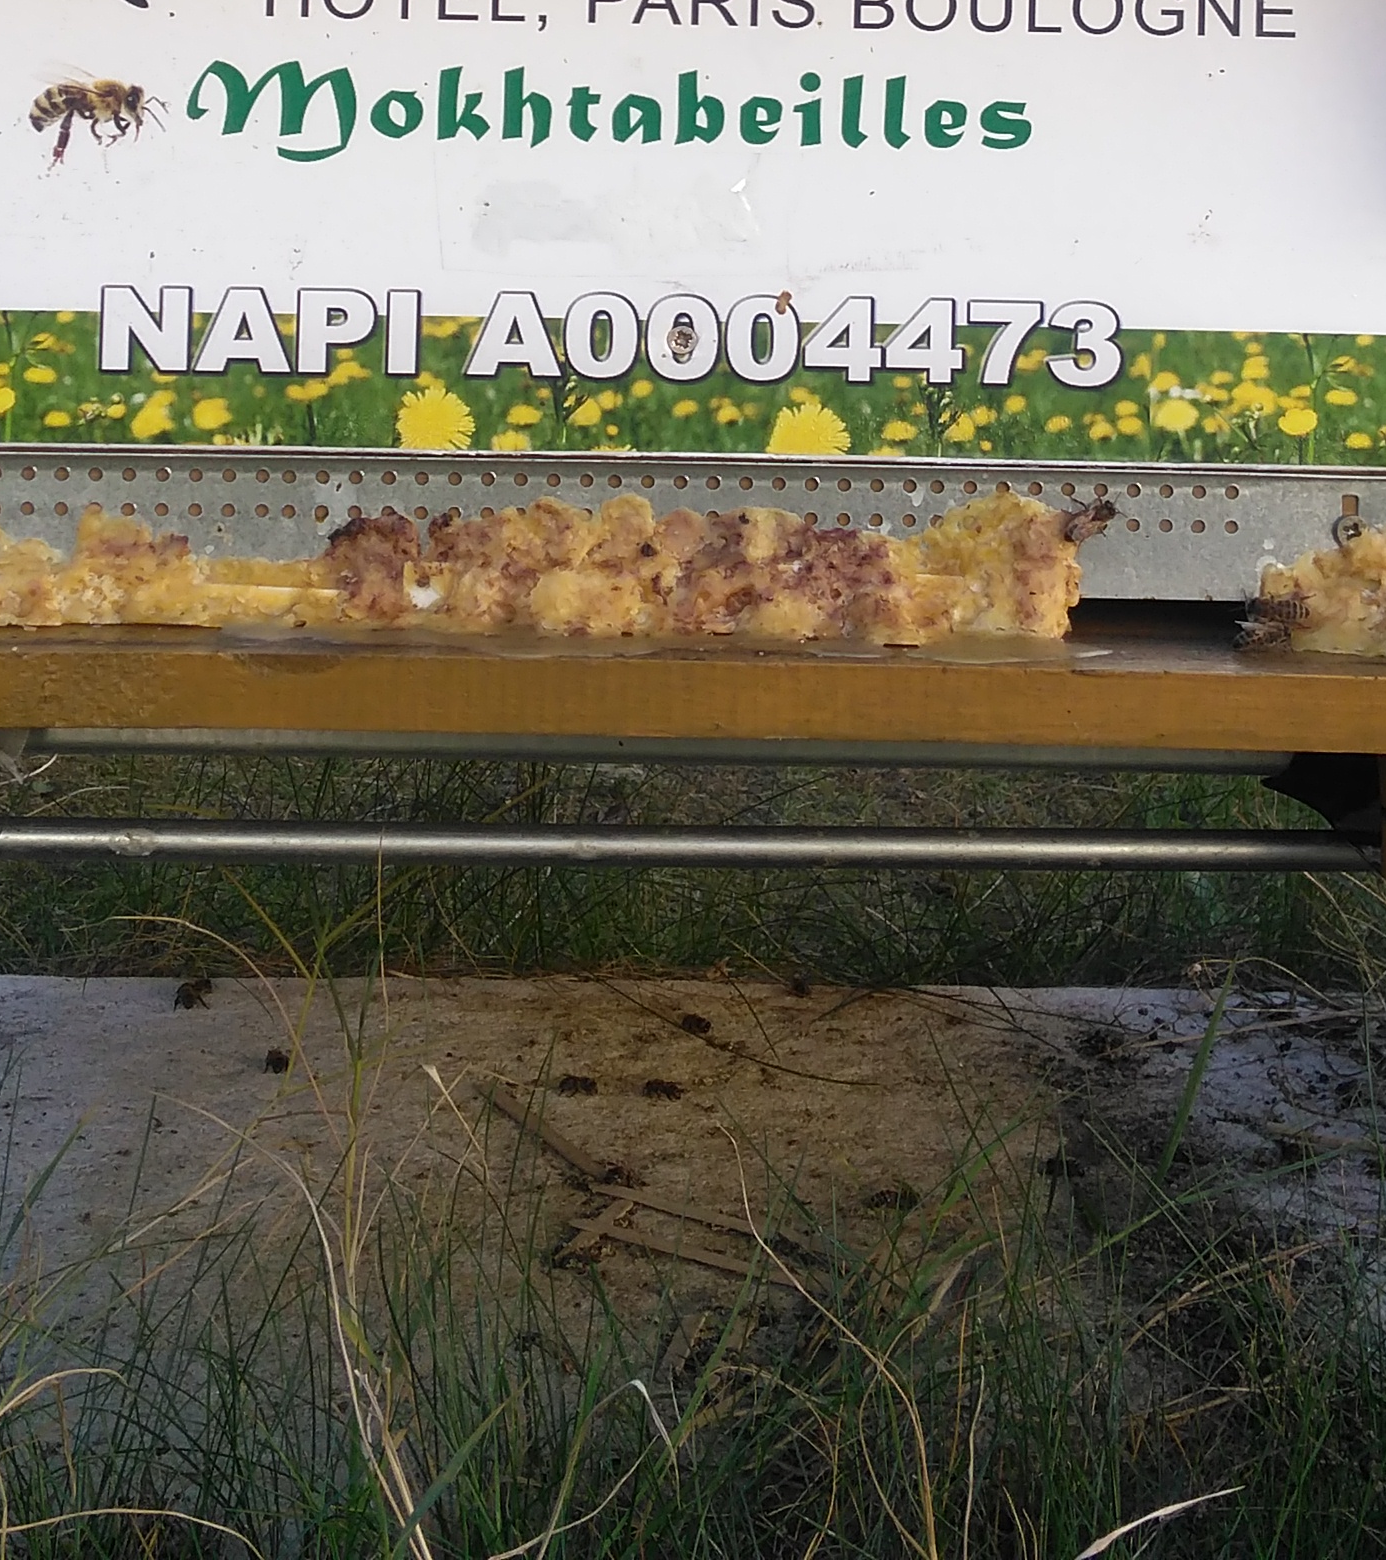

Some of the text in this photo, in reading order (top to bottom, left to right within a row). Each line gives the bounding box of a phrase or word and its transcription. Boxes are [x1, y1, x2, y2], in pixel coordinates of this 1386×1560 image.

[186, 59, 1033, 163] Mokhtabeilles
[99, 284, 1124, 388] NAPI A0004473
